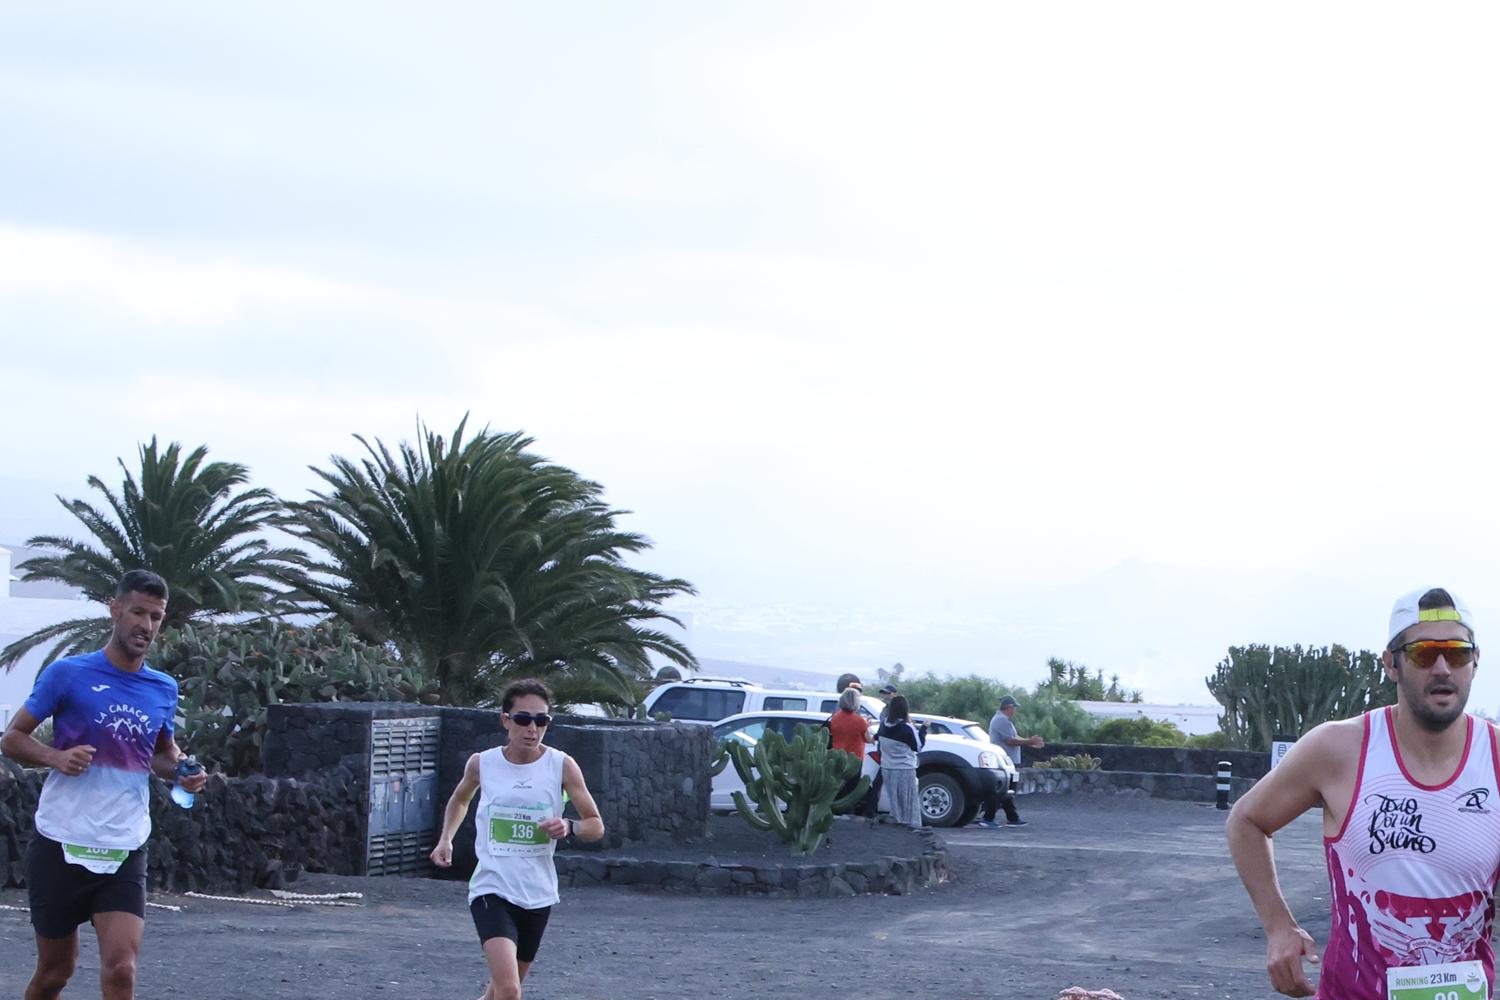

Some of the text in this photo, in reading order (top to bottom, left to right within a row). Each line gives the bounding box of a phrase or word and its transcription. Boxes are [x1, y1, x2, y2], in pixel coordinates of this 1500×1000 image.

[94, 711, 108, 724] LA
[511, 823, 534, 840] 136
[1395, 976, 1429, 987] RUNNING
[1430, 973, 1443, 985] 23
[1443, 972, 1457, 983] Km
